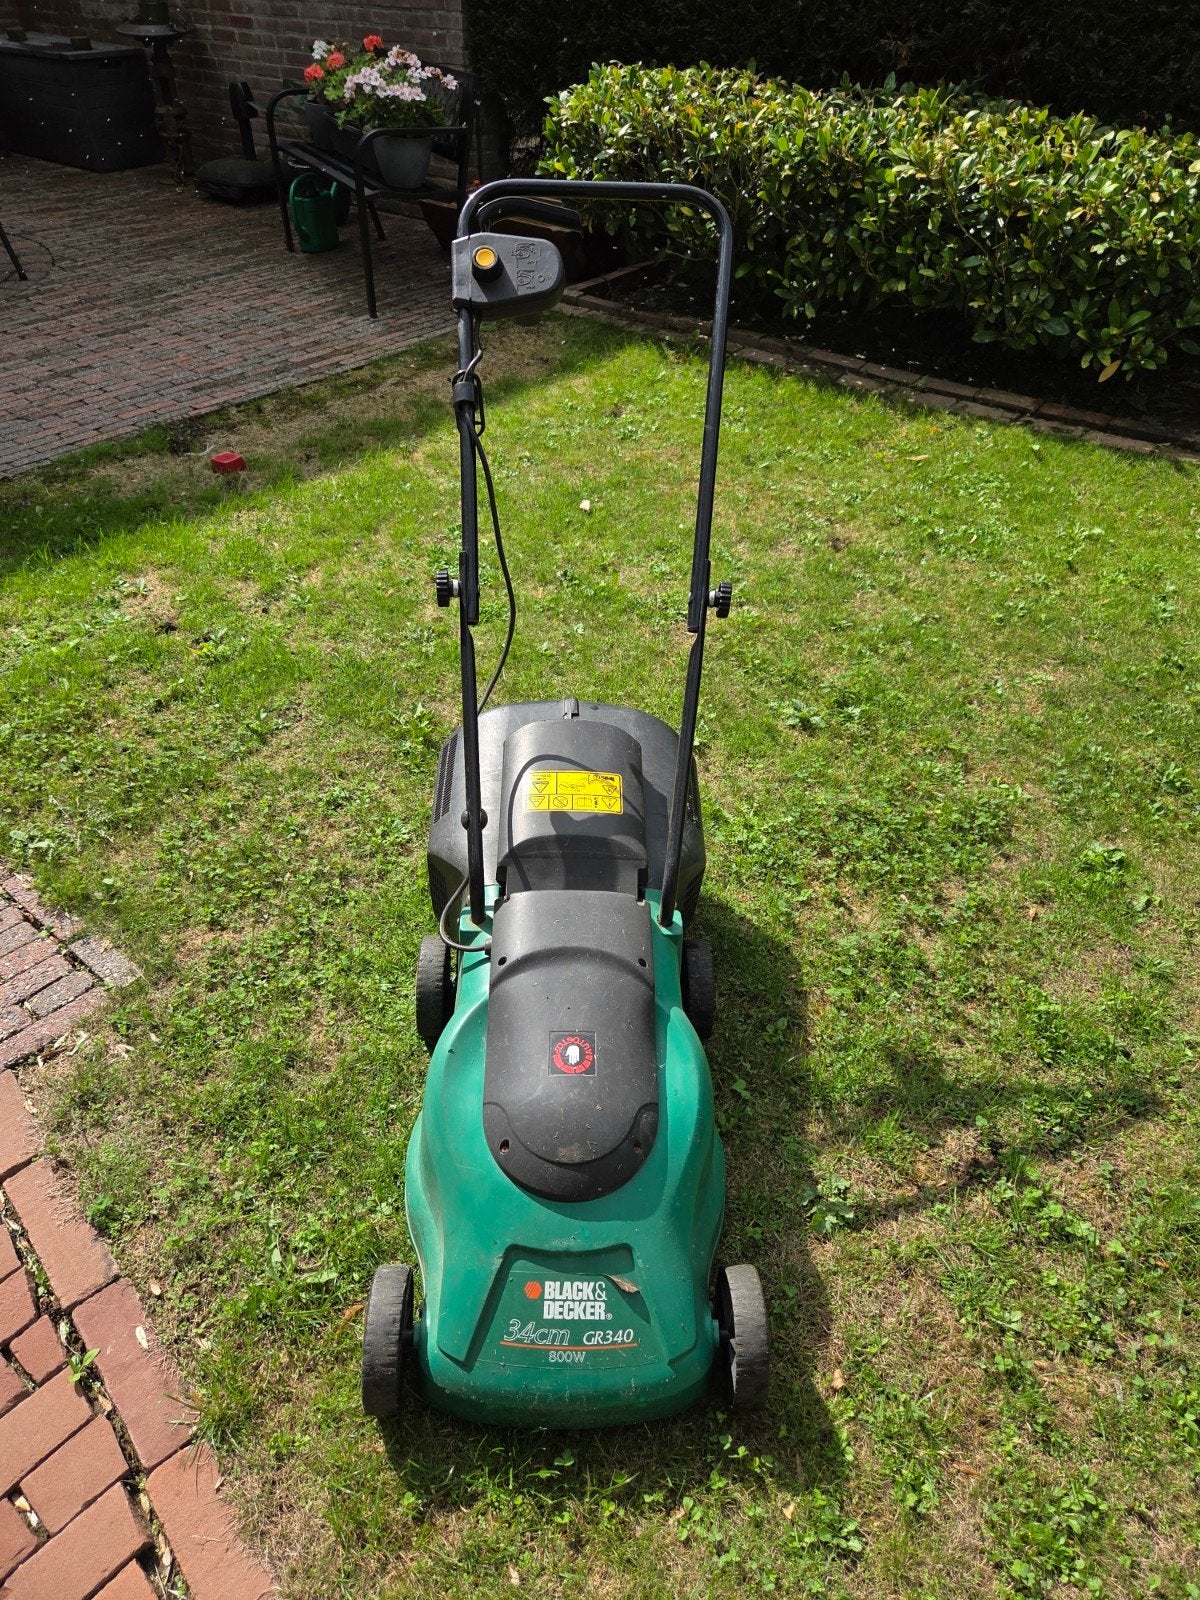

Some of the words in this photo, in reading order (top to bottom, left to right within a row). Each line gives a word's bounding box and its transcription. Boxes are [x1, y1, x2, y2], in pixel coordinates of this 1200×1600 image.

[544, 1281, 607, 1300] BLACK&
[503, 1318, 570, 1346] 34cm
[583, 1328, 634, 1345] GR340
[549, 1350, 586, 1363] 800W
